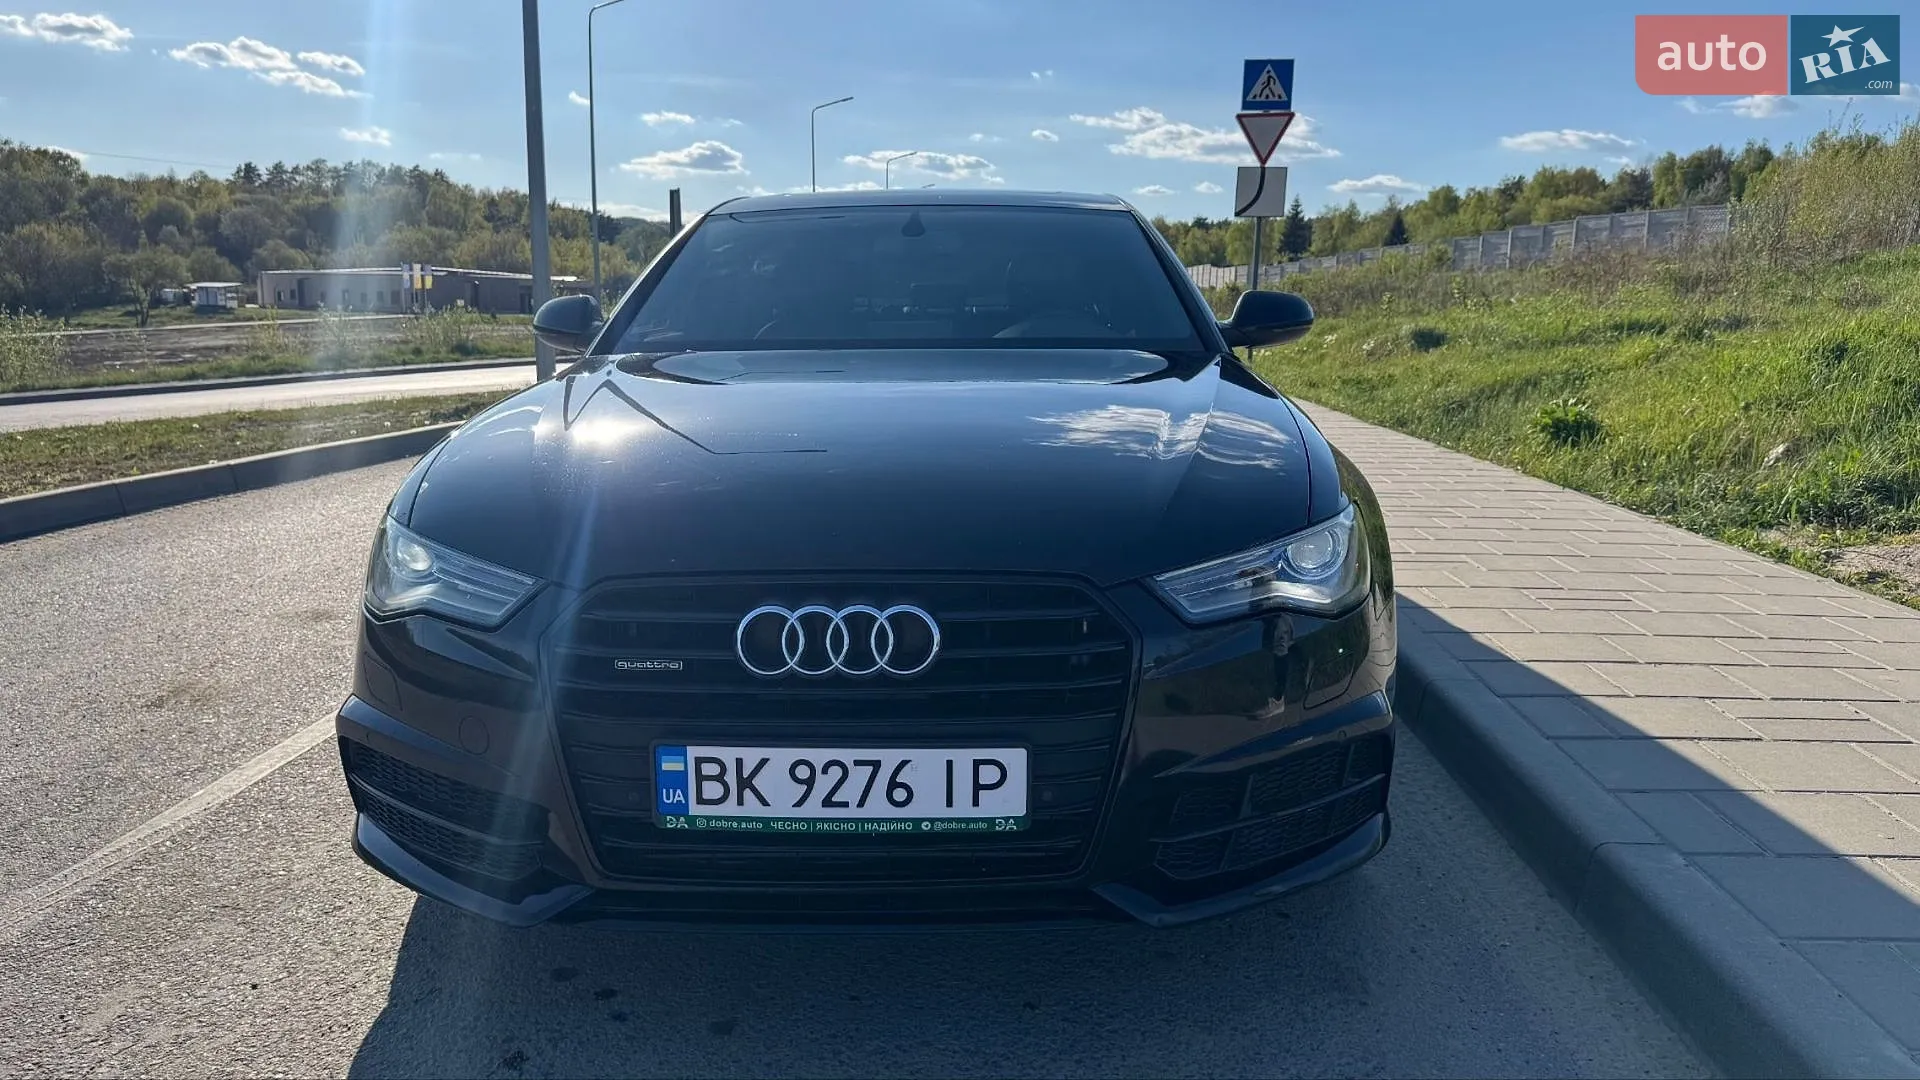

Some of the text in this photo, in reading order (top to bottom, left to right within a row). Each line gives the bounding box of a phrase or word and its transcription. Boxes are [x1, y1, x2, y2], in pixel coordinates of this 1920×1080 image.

[617, 661, 679, 669] quattro
[694, 756, 1008, 808] BK 9276 IP
[662, 788, 685, 804] UA
[709, 819, 763, 830] dobre.auto
[770, 820, 913, 832] ЧЕСНО ЯКІСНО НАДІЙНО
[933, 820, 988, 831] @dobre.auto
